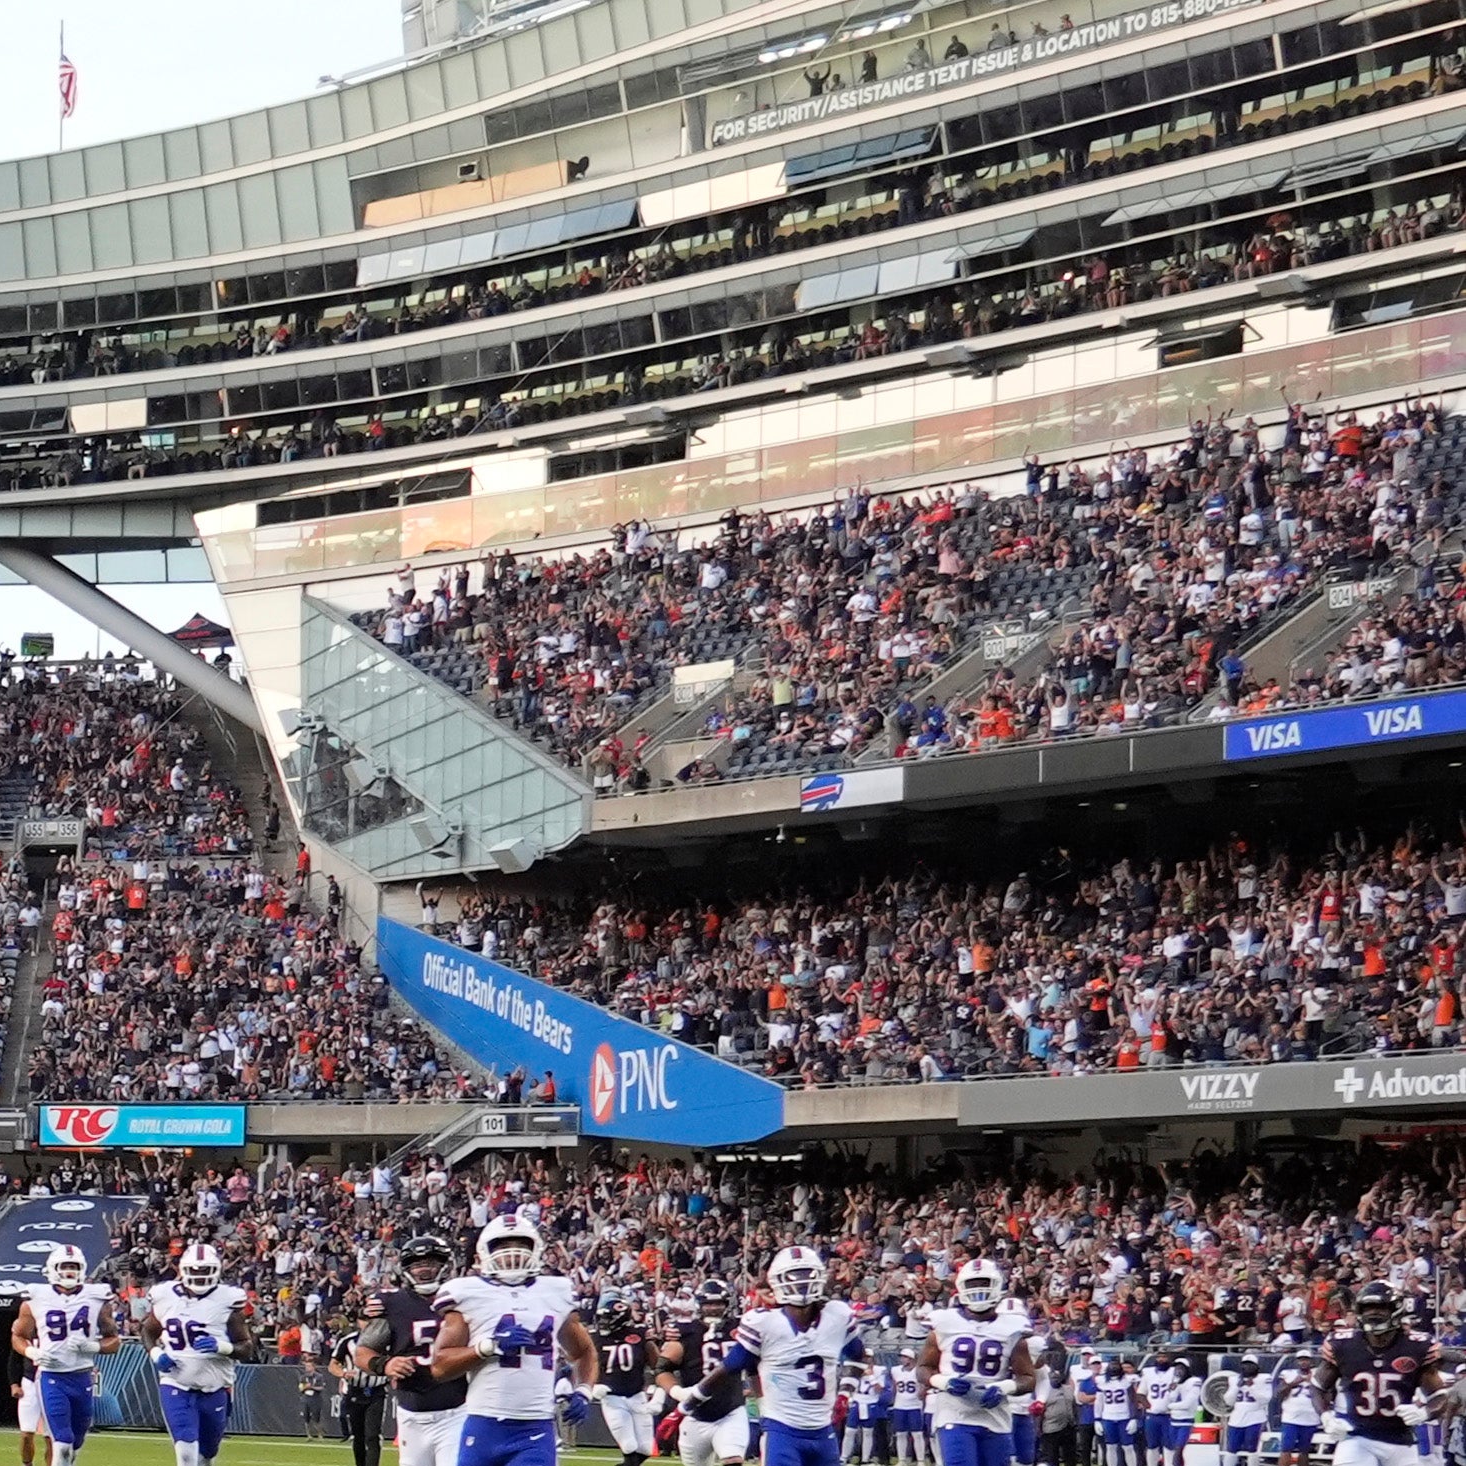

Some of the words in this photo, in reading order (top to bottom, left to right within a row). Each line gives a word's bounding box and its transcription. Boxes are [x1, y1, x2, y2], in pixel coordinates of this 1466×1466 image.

[712, 121, 746, 143] FOR
[748, 71, 924, 134] SECURITY/ASSISTANCE
[928, 60, 969, 88] TEXT
[972, 46, 1019, 76] ISSUE
[1021, 42, 1034, 62] &
[1036, 22, 1120, 59] LOCATION
[1124, 14, 1148, 34] TO
[1244, 721, 1302, 752] VISA
[1363, 704, 1423, 736] VISA
[423, 951, 463, 998] Official
[465, 965, 495, 1012] Bank
[495, 984, 514, 1019] of
[512, 992, 533, 1029] the
[533, 1000, 573, 1055] Bears
[619, 1043, 679, 1114] PNC
[1179, 1072, 1260, 1100] VIZZY
[49, 1108, 119, 1143] RC
[129, 1118, 162, 1134] ROYAL
[163, 1118, 202, 1134] CROWN
[203, 1118, 232, 1134] COLA
[484, 1117, 504, 1132] 101
[1237, 1294, 1253, 1312] 22
[45, 1306, 91, 1342] 94
[601, 1344, 635, 1374] 70
[951, 1336, 1003, 1378] 98
[794, 1354, 827, 1400] 3
[1353, 1372, 1405, 1417] 35
